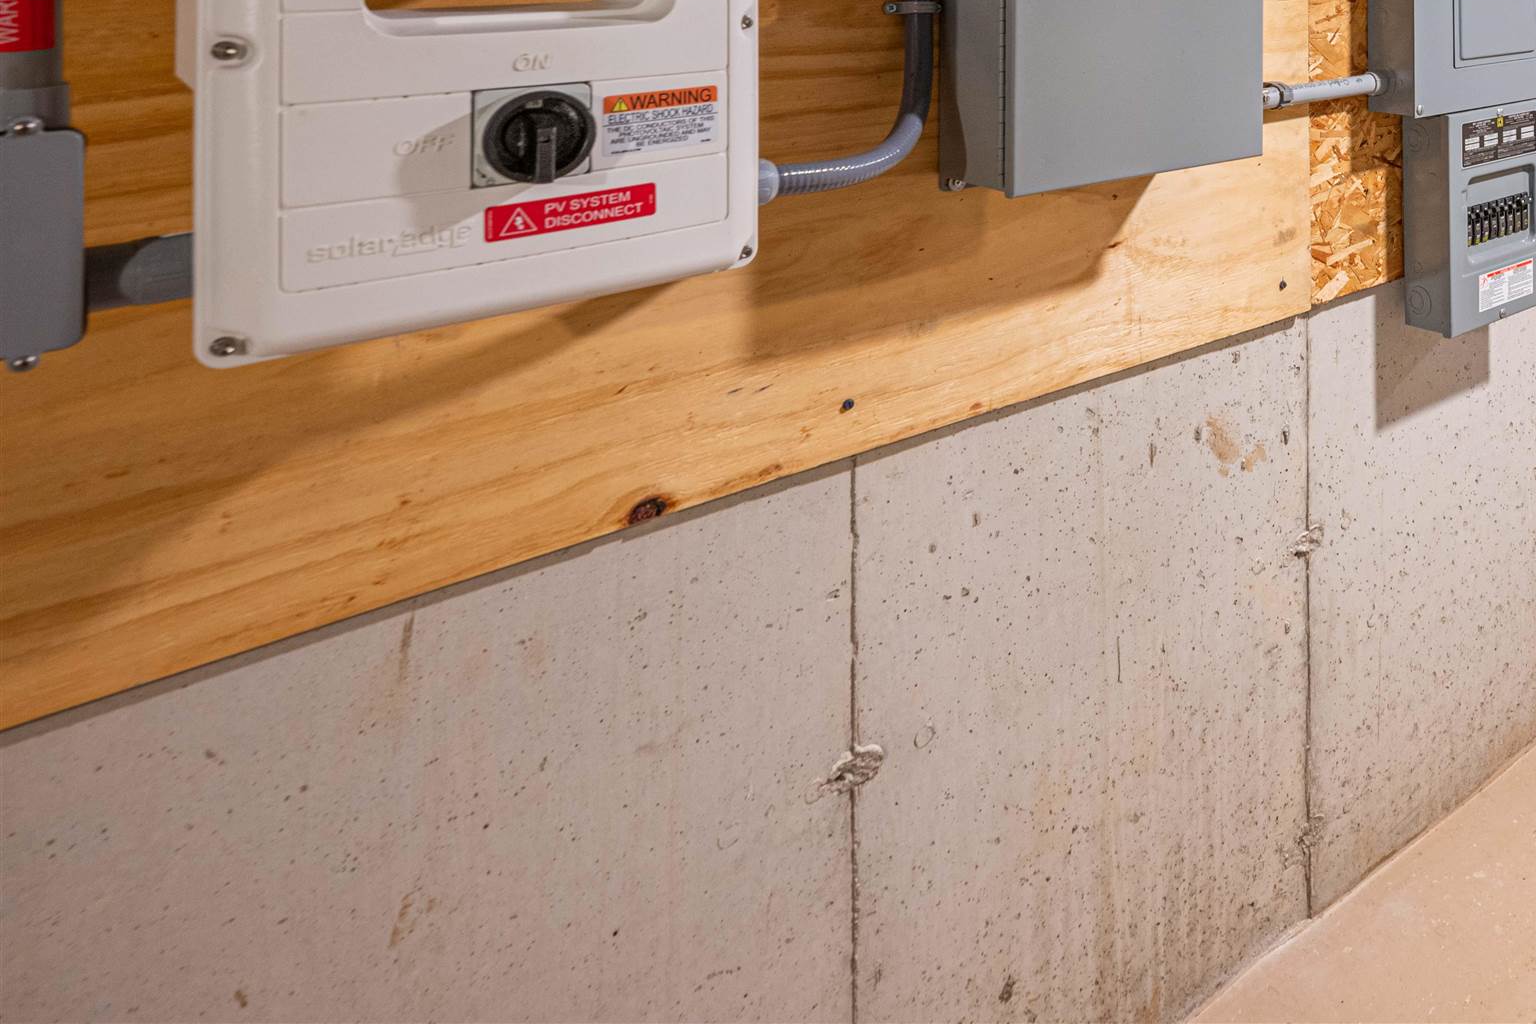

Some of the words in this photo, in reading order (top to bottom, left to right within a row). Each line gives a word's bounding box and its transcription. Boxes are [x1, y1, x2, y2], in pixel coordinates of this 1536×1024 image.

[512, 53, 552, 73] ON
[630, 88, 712, 110] WARNING
[607, 112, 651, 124] ELECTRIC
[652, 108, 679, 119] SHOCK
[682, 104, 714, 115] HAZARD
[393, 133, 456, 157] OFF
[544, 201, 567, 215] PV
[569, 191, 632, 211] SYSTEM
[544, 201, 643, 229] DISCONNECT
